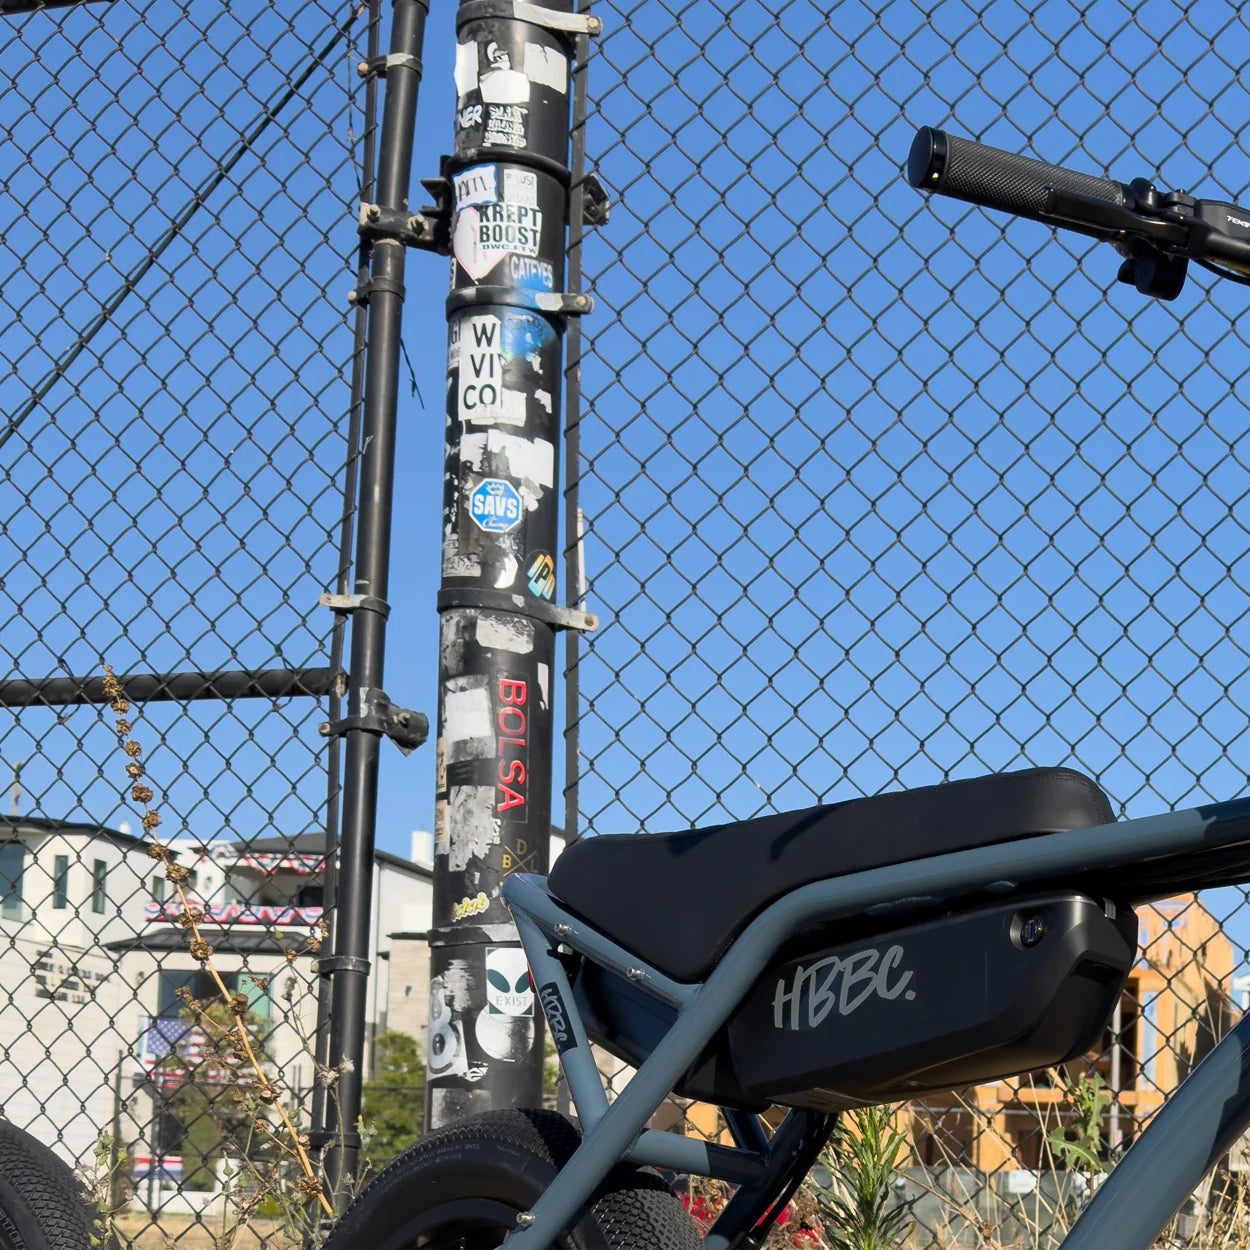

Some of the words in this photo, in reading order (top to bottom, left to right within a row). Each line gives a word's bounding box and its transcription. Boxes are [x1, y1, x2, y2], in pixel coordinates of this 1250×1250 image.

[478, 203, 541, 228] KREPT
[479, 224, 539, 247] BOOST
[511, 255, 554, 288] CATEYES
[473, 494, 518, 518] SAVS
[497, 678, 527, 812] BOLSA
[496, 995, 529, 1007] EXIST
